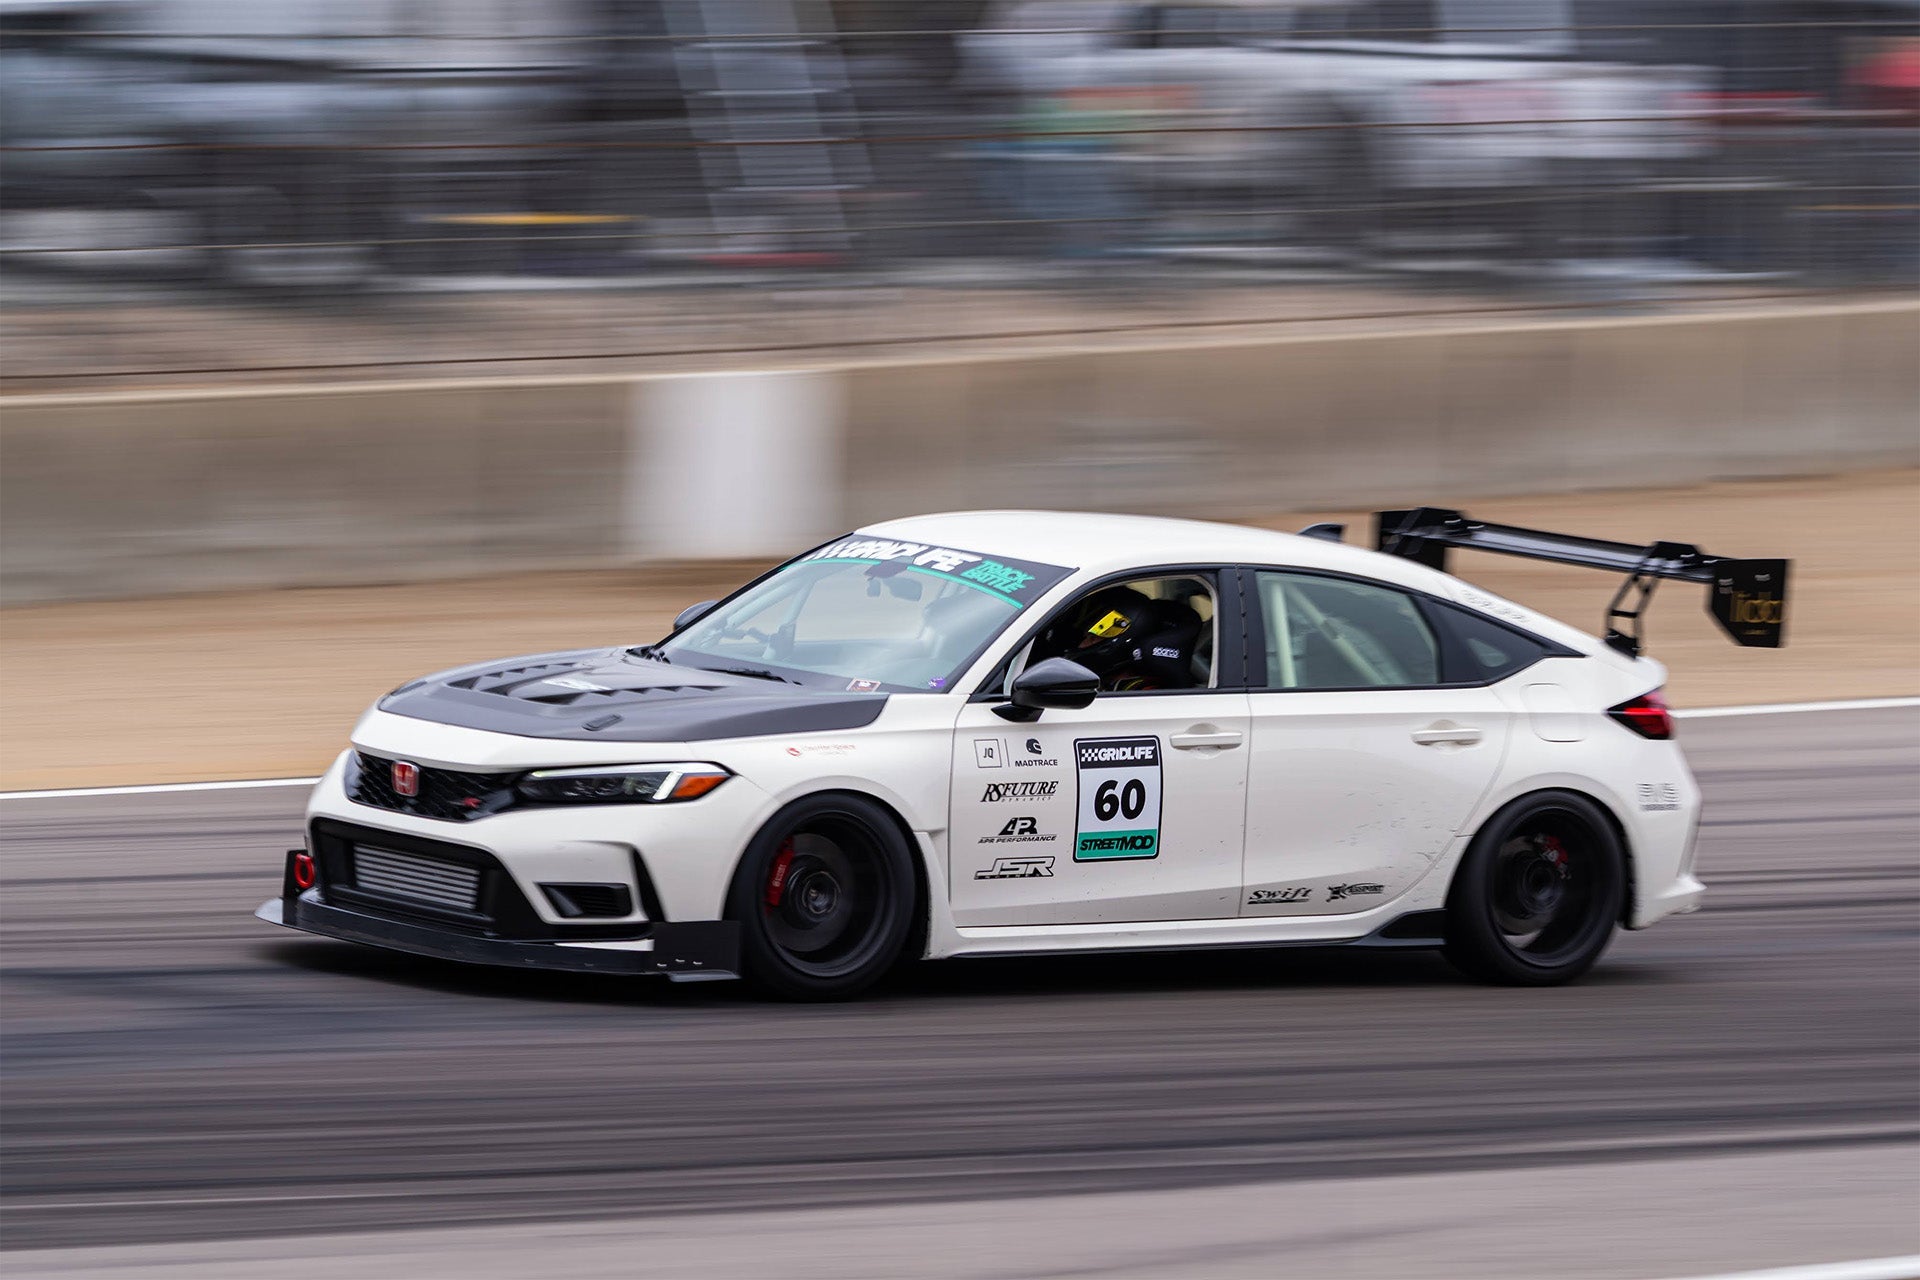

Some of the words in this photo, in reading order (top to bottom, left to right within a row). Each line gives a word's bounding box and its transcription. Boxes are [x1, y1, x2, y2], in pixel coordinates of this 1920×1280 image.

[977, 560, 1035, 583] TRACK
[961, 570, 1025, 593] BATTLE
[983, 747, 994, 760] JQ
[1098, 746, 1155, 762] GRIDLIFE
[1015, 759, 1058, 767] MADTRACE
[1094, 778, 1146, 822] 60
[996, 835, 1057, 844] PERFORMANCE
[974, 856, 1056, 881] JSR
[1249, 887, 1313, 900] Swift
